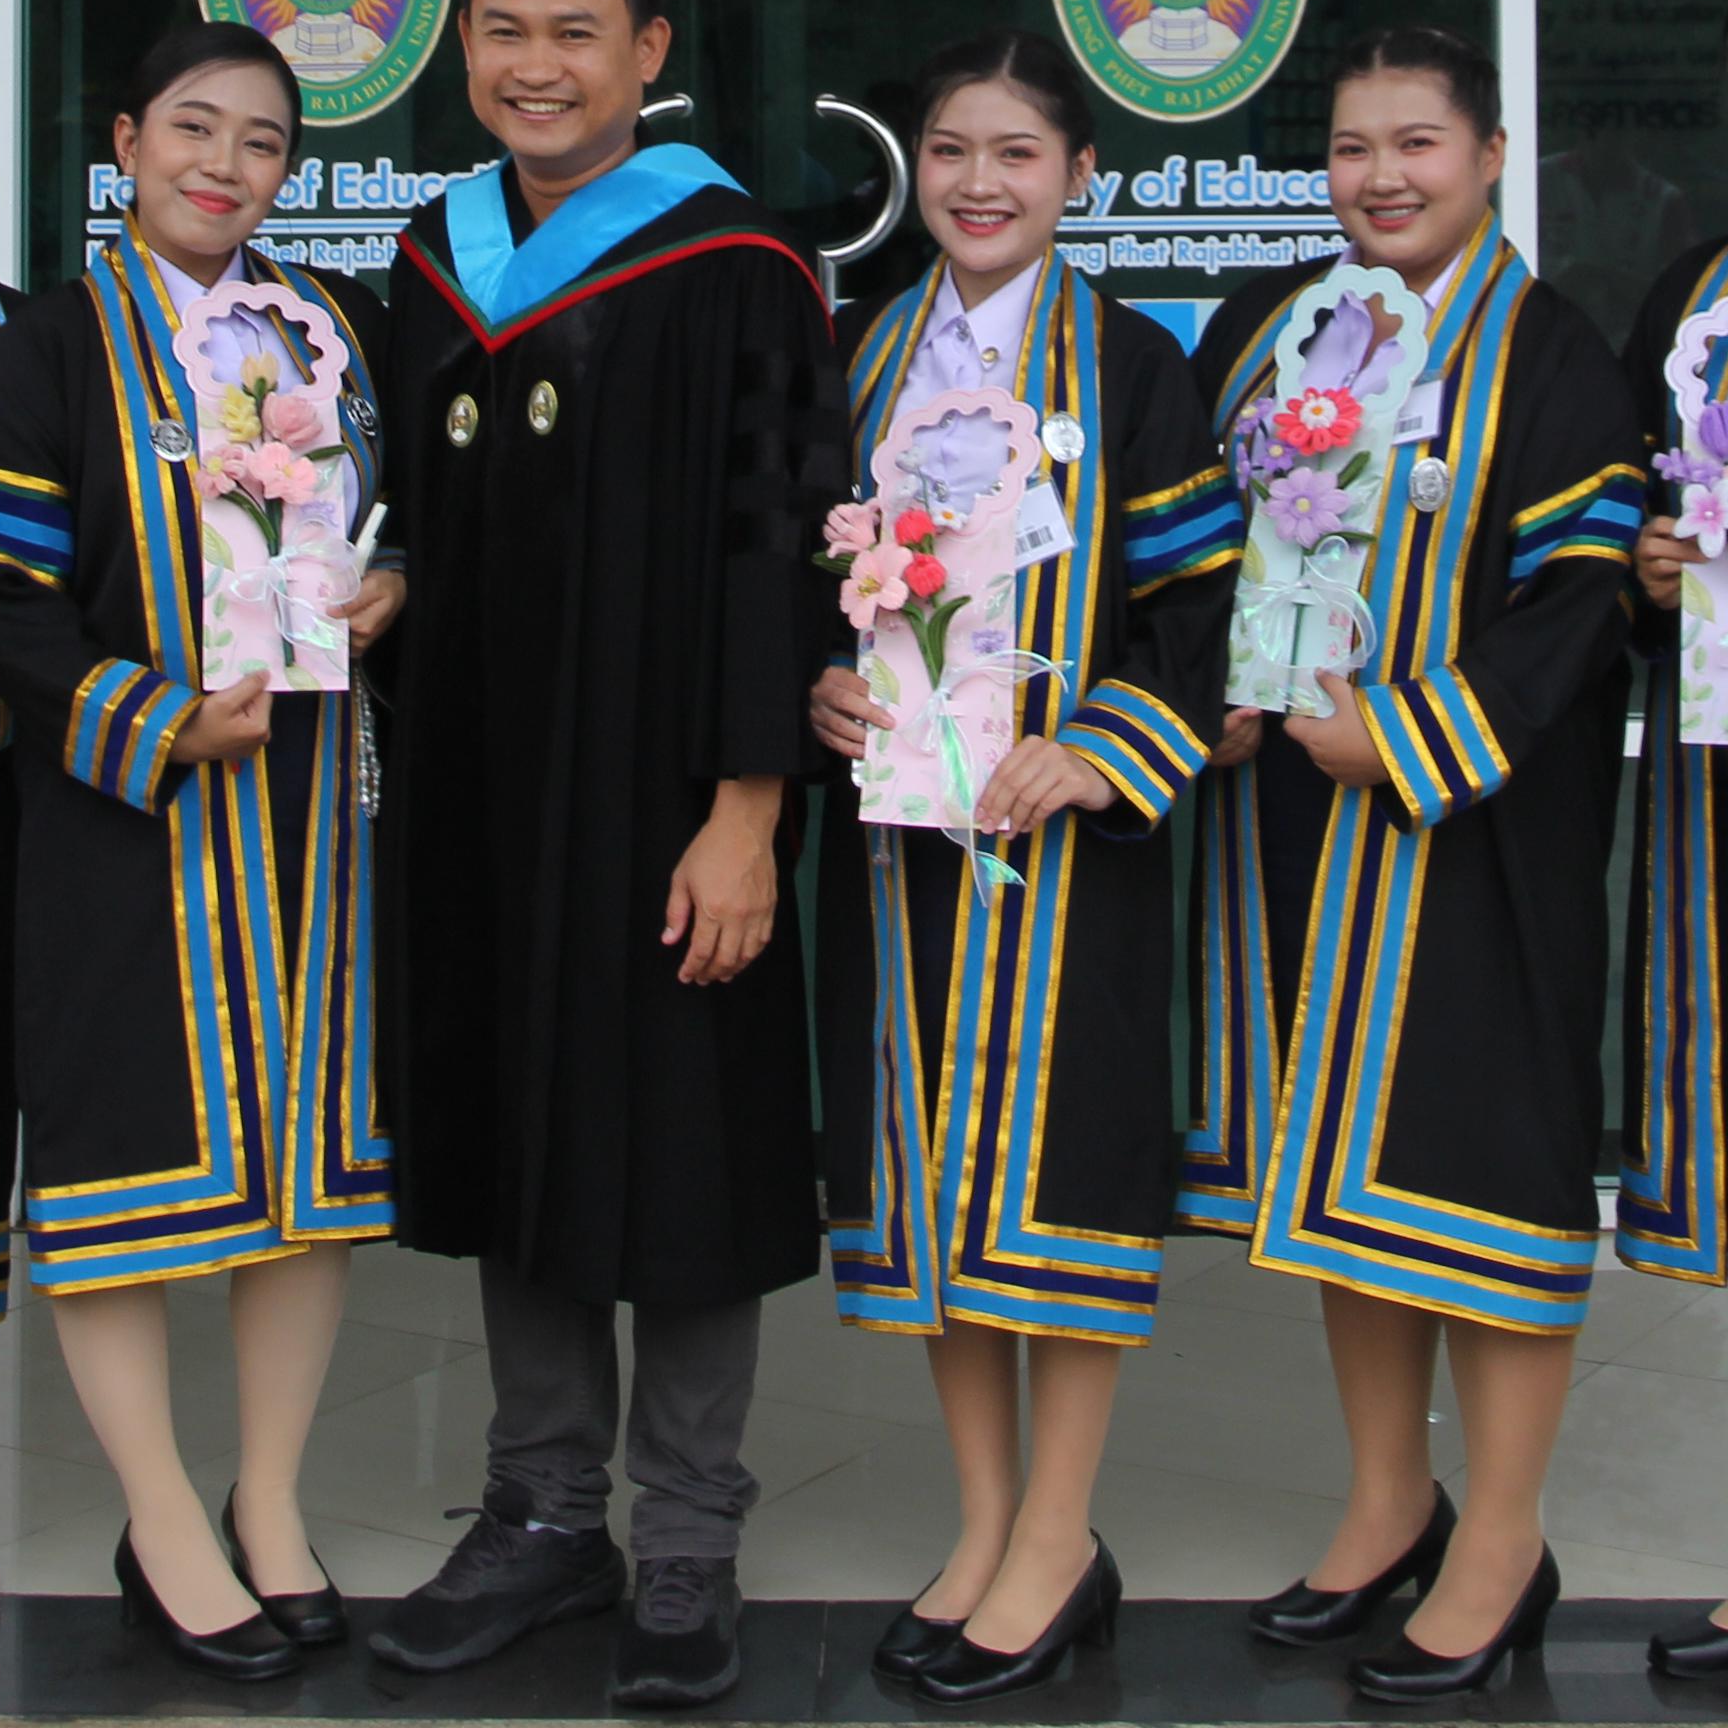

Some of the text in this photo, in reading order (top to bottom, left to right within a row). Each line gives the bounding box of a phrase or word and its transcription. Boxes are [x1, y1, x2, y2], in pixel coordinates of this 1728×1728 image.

[311, 54, 408, 112] RAJABHAT
[1103, 60, 1152, 98] PHET
[1164, 53, 1264, 109] RAJABHAT
[273, 158, 322, 210] of
[1131, 154, 1187, 207] of
[1194, 154, 1330, 207] Educa
[310, 237, 399, 276] Rajabh
[1108, 233, 1170, 267] Phet
[1171, 233, 1296, 274] Rajabhat
